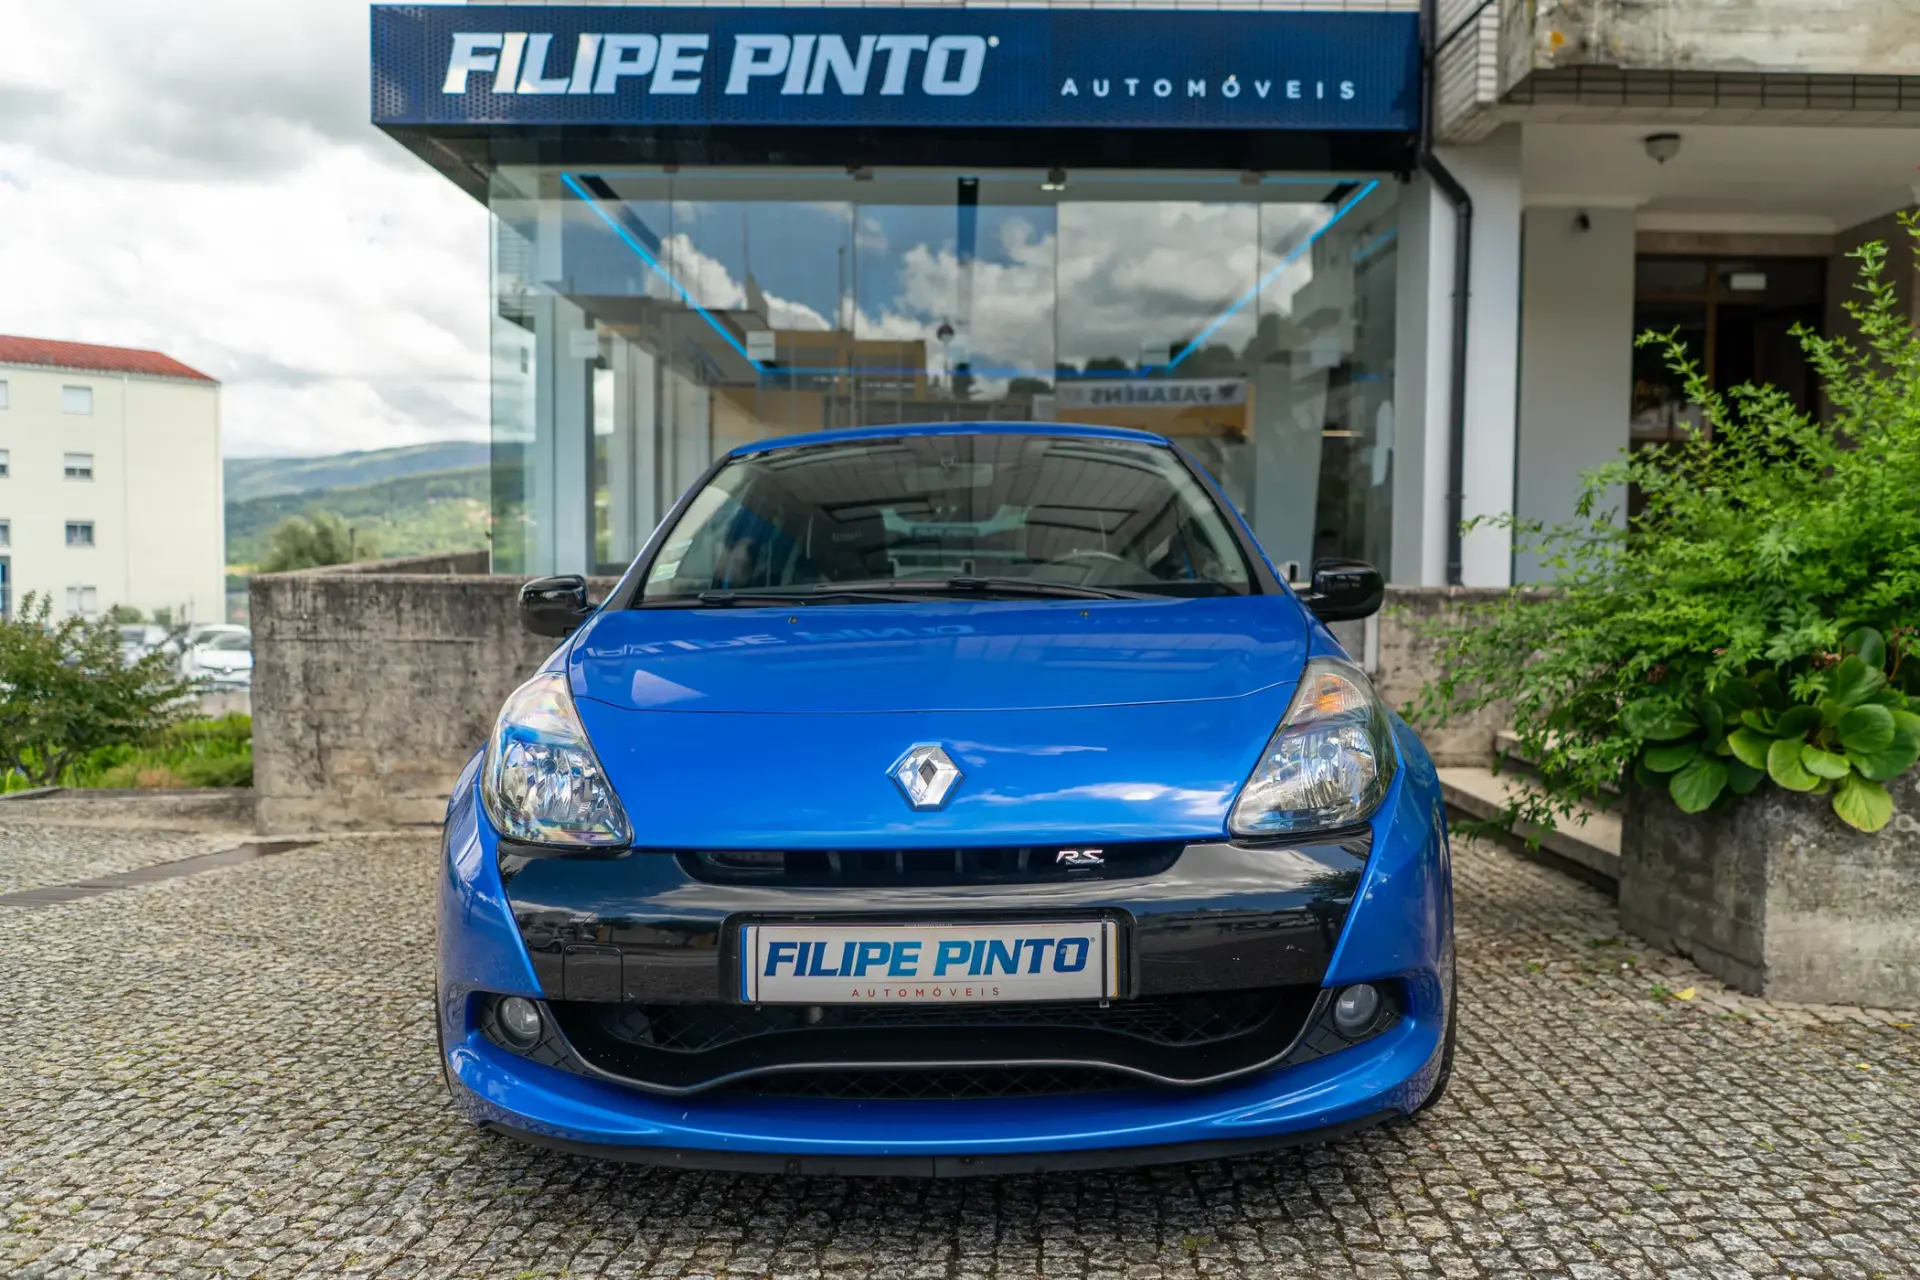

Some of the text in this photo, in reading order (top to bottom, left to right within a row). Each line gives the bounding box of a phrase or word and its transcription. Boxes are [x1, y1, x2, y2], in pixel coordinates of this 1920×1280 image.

[442, 32, 988, 96] FILIPE PINTO
[1060, 74, 1355, 99] AUTOMÓVEIS
[1056, 849, 1103, 864] RS
[763, 937, 1090, 977] FILIPE PINTO
[851, 986, 999, 998] AUTOMÓVEIS
